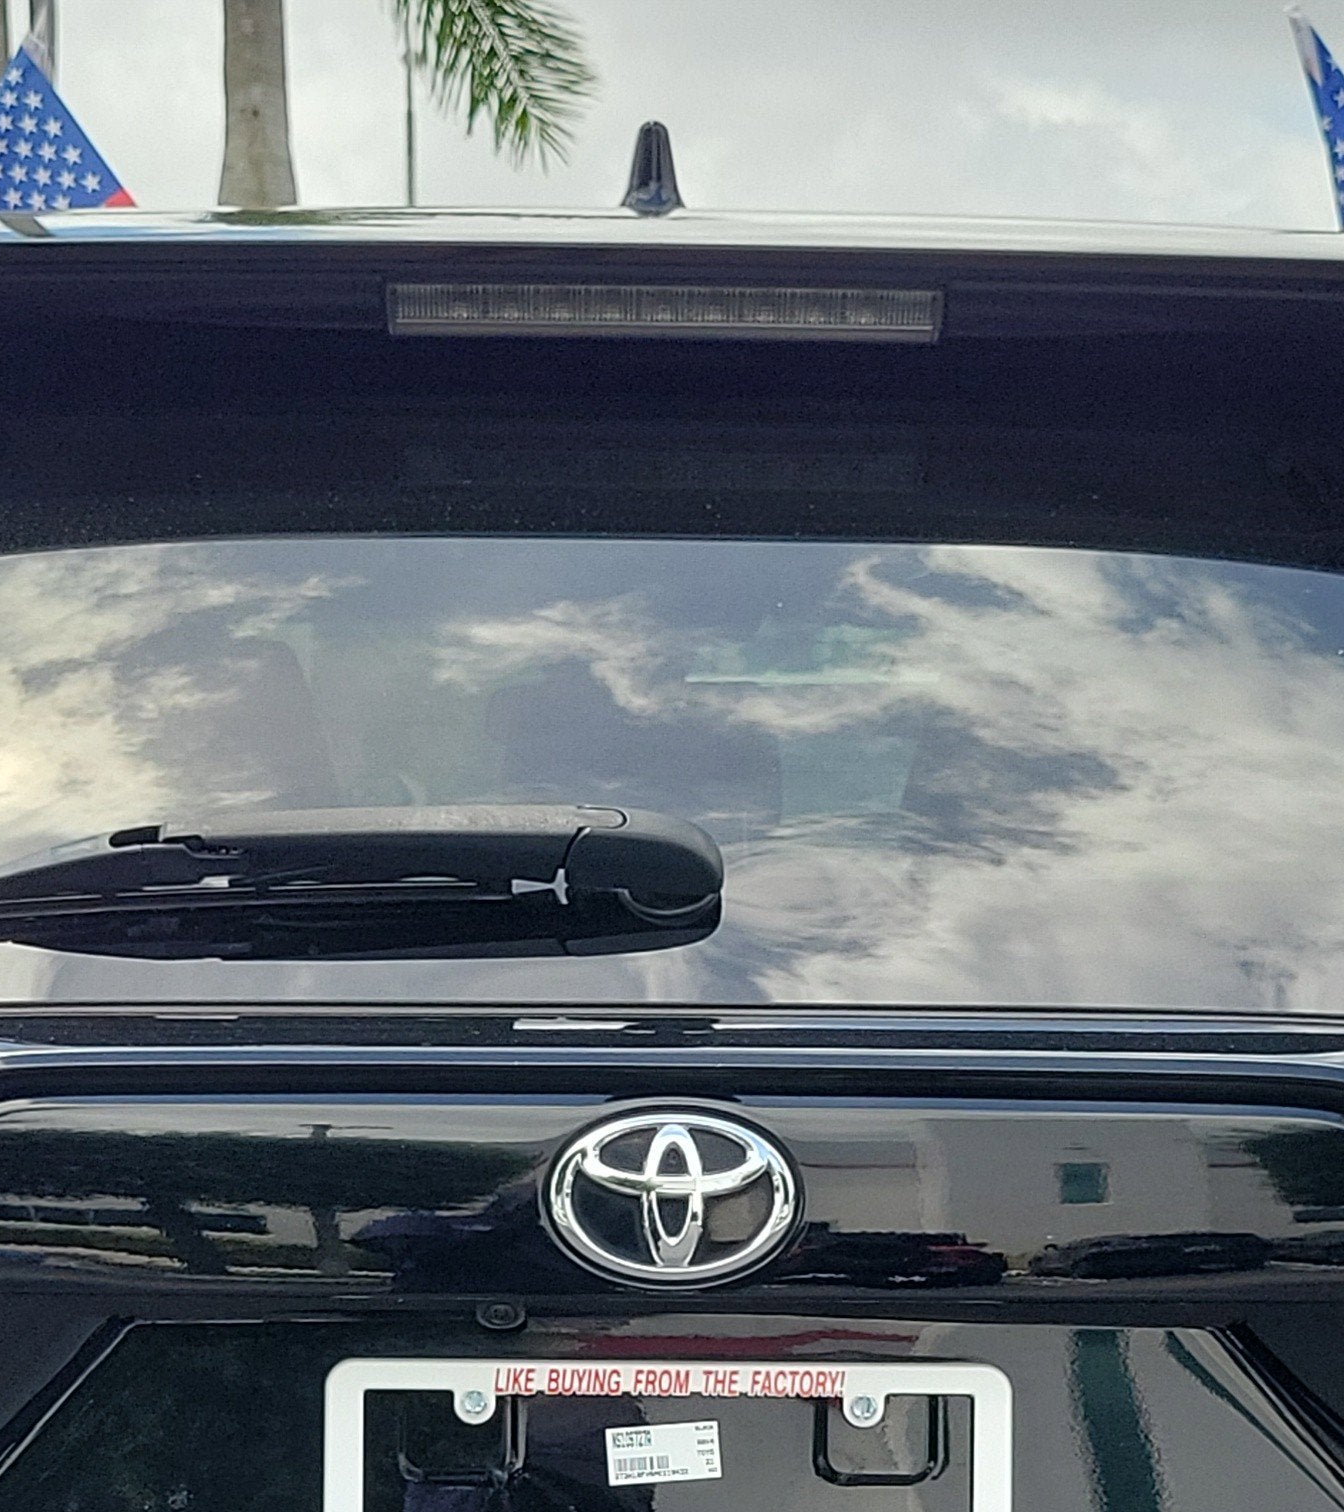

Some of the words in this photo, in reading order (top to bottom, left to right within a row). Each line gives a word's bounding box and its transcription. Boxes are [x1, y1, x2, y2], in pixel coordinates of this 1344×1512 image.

[494, 1367, 536, 1394] LIKE
[547, 1368, 622, 1395] BUYING
[633, 1369, 690, 1395] FROM
[703, 1369, 740, 1395] THE
[750, 1370, 846, 1396] FACTORY!
